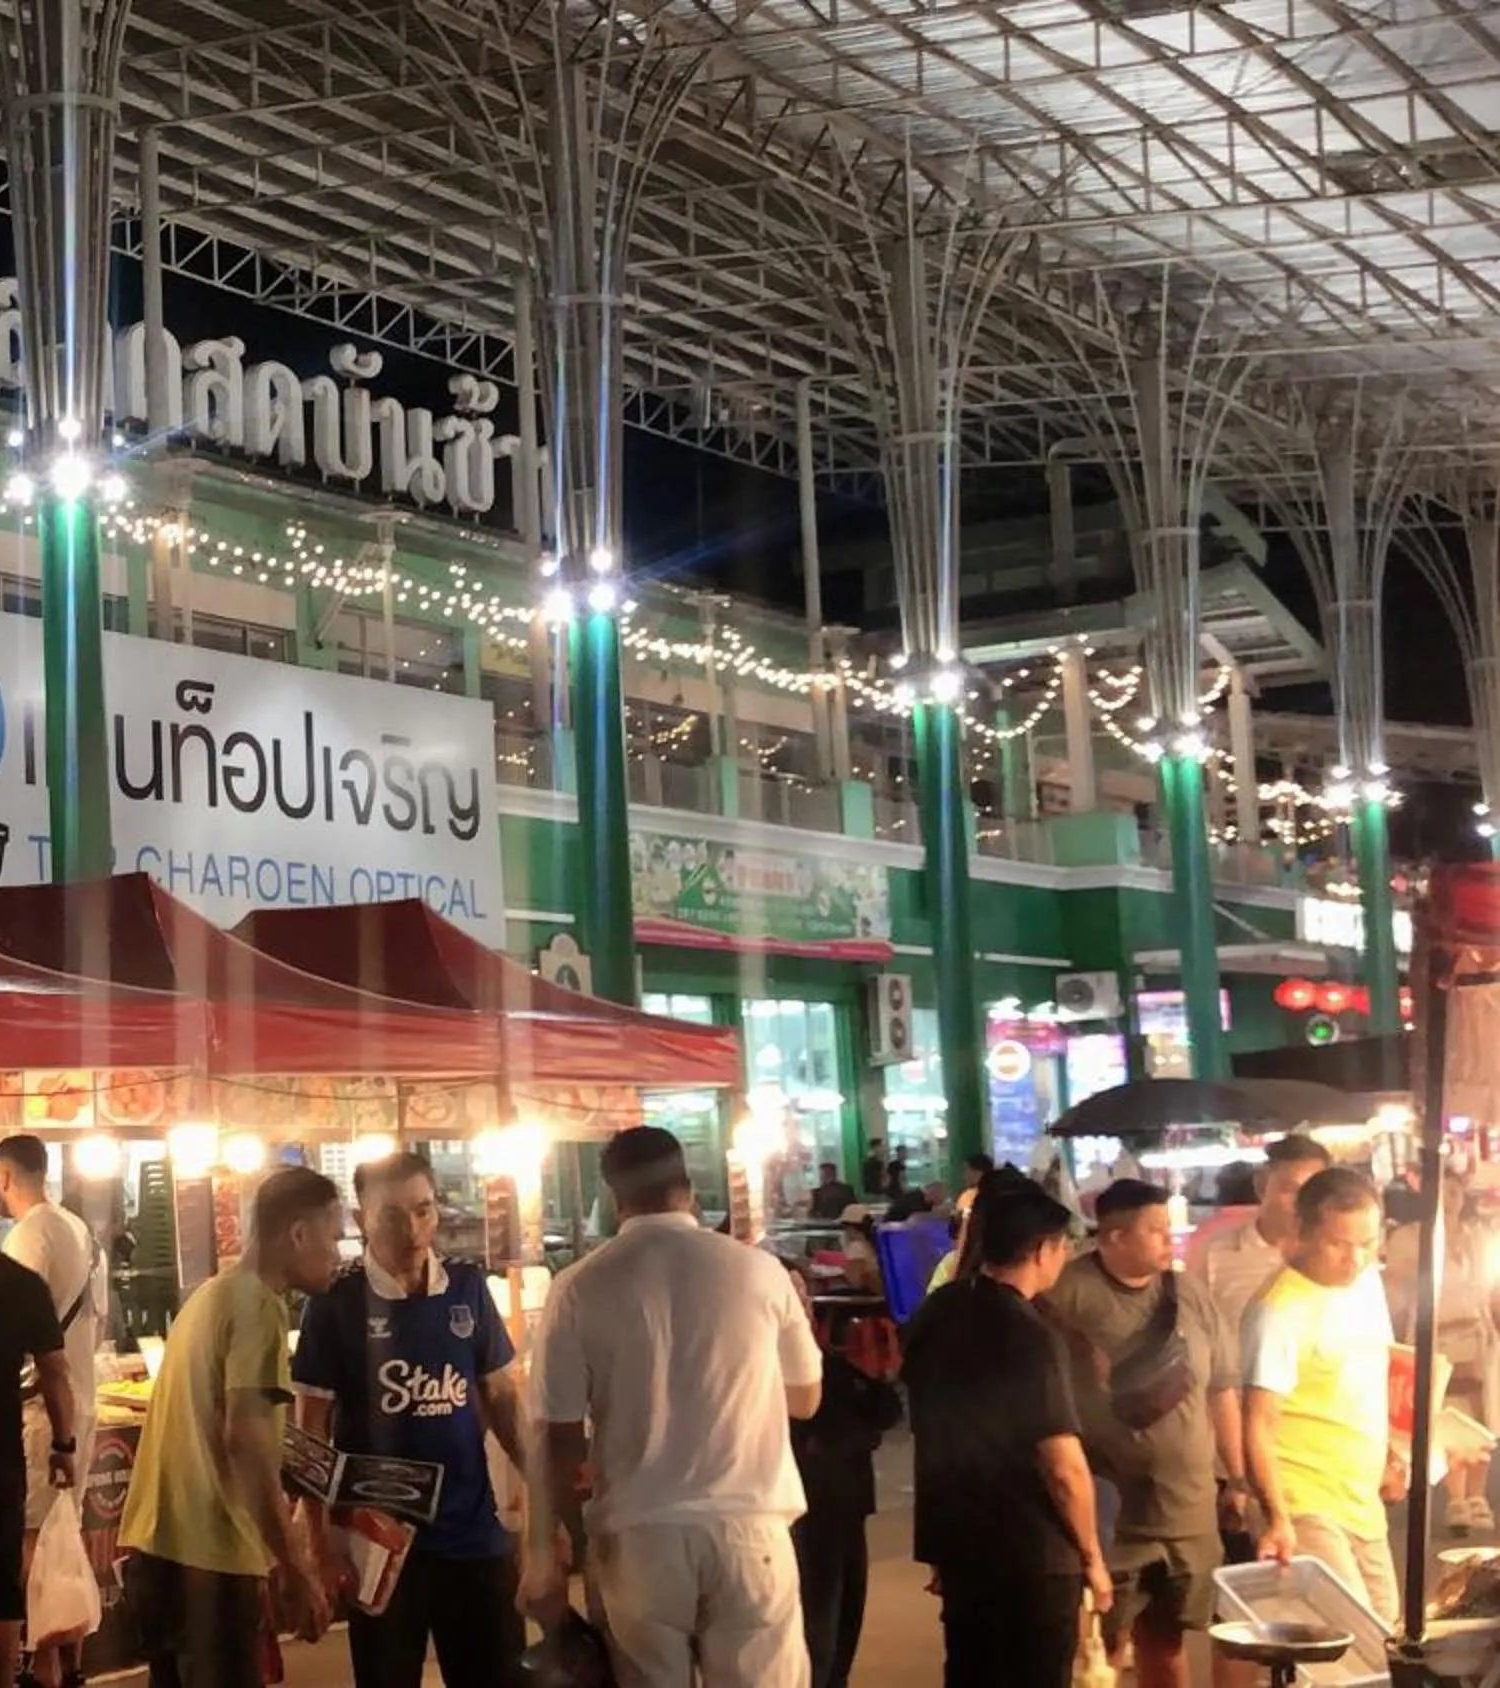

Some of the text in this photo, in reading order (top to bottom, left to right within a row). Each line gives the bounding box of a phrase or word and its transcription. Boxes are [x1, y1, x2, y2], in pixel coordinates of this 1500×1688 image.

[135, 845, 336, 906] CHAROEN
[349, 867, 488, 919] OPTICAL
[378, 1359, 468, 1415] Stake
[412, 1402, 453, 1417] .com
